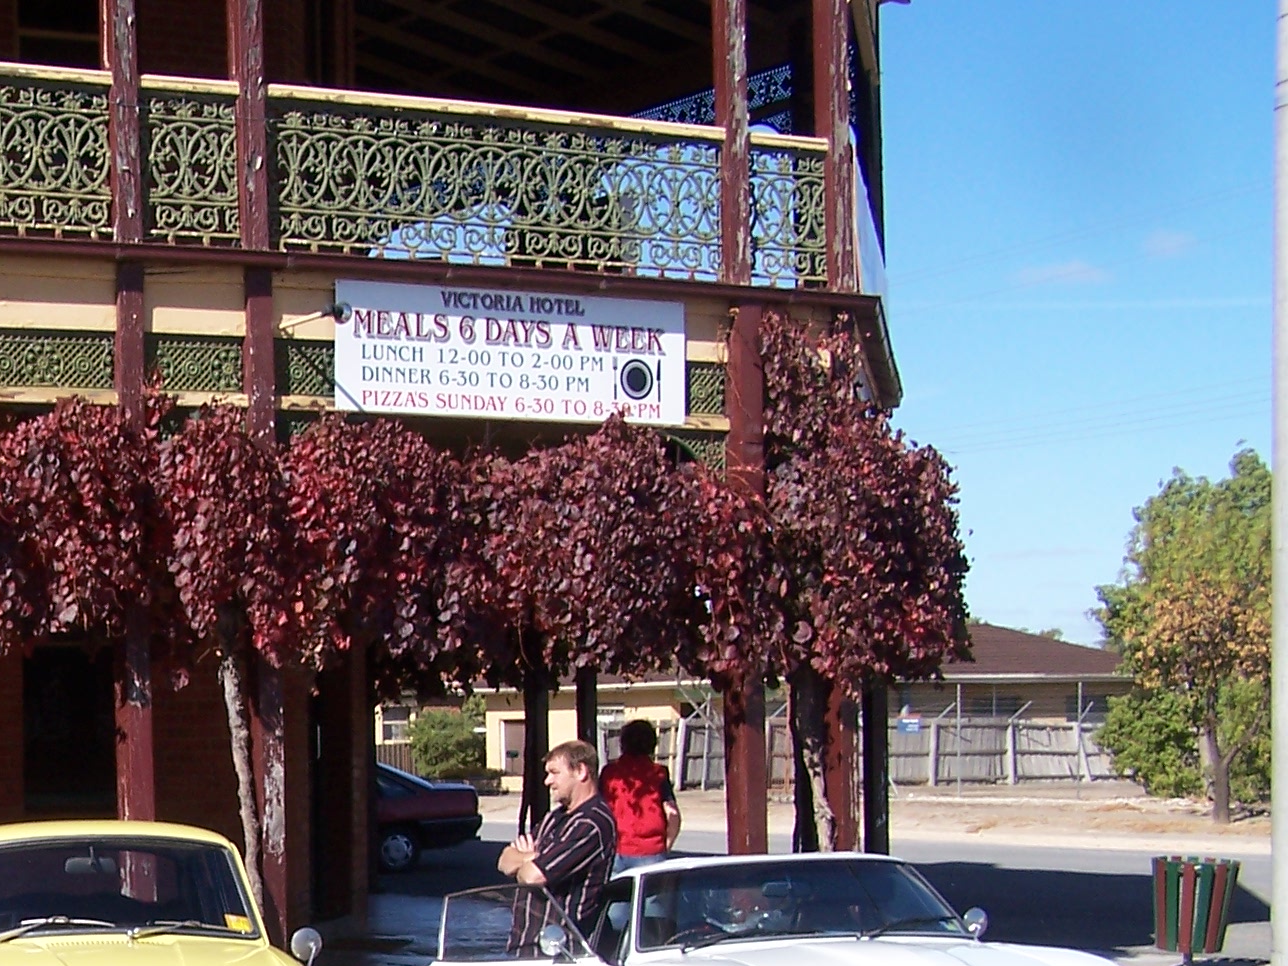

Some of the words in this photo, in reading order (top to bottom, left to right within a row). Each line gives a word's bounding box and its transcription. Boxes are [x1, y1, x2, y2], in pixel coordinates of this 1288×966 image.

[441, 291, 524, 313] VICTORIA
[530, 296, 585, 316] HOTEL
[353, 309, 450, 342] MEALS
[459, 316, 476, 344] 6
[485, 317, 552, 349] DAYS
[562, 322, 582, 350] A
[591, 324, 666, 356] WEEK
[362, 344, 423, 362] LUNCH
[438, 348, 491, 366] 12-00
[498, 351, 524, 368] TO
[532, 353, 573, 370] 2-00
[580, 355, 603, 371] PM
[362, 366, 431, 384] DINNER
[439, 370, 479, 386] 6-30
[486, 372, 513, 389] TO
[519, 374, 559, 391] 8-30
[566, 376, 589, 392] PM
[362, 390, 429, 408] PIZZA'S
[436, 393, 508, 411] SUNDAY
[515, 397, 554, 414] 6-30
[561, 399, 586, 415] TO
[638, 402, 660, 418] PM
